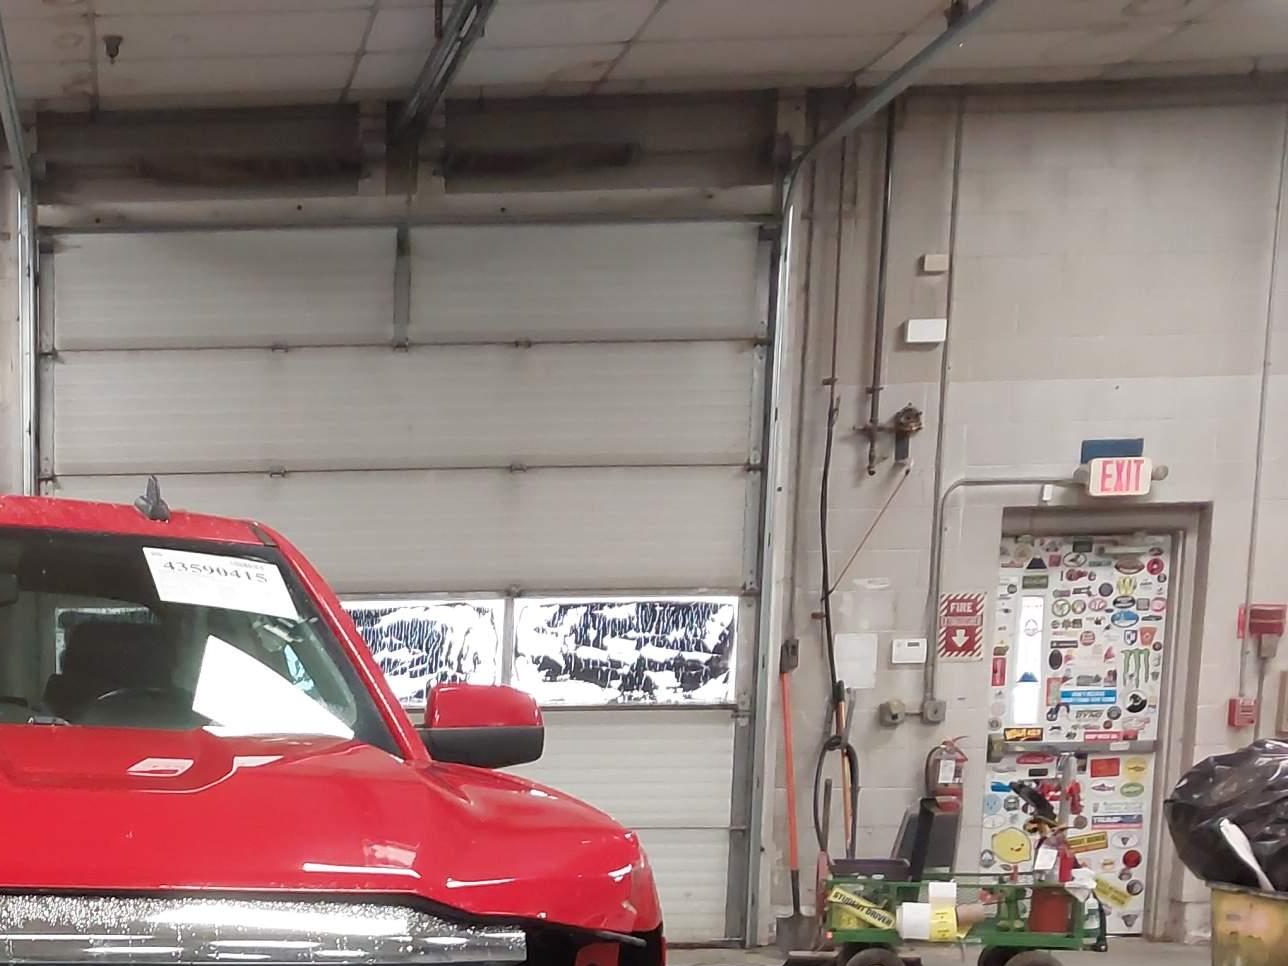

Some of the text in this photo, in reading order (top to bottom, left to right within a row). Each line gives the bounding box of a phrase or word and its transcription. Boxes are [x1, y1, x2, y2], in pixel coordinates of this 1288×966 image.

[1100, 459, 1145, 492] EXIT
[162, 560, 268, 584] 43590415
[950, 602, 973, 613] FIRE
[832, 891, 893, 927] STUDENT DRIVER
